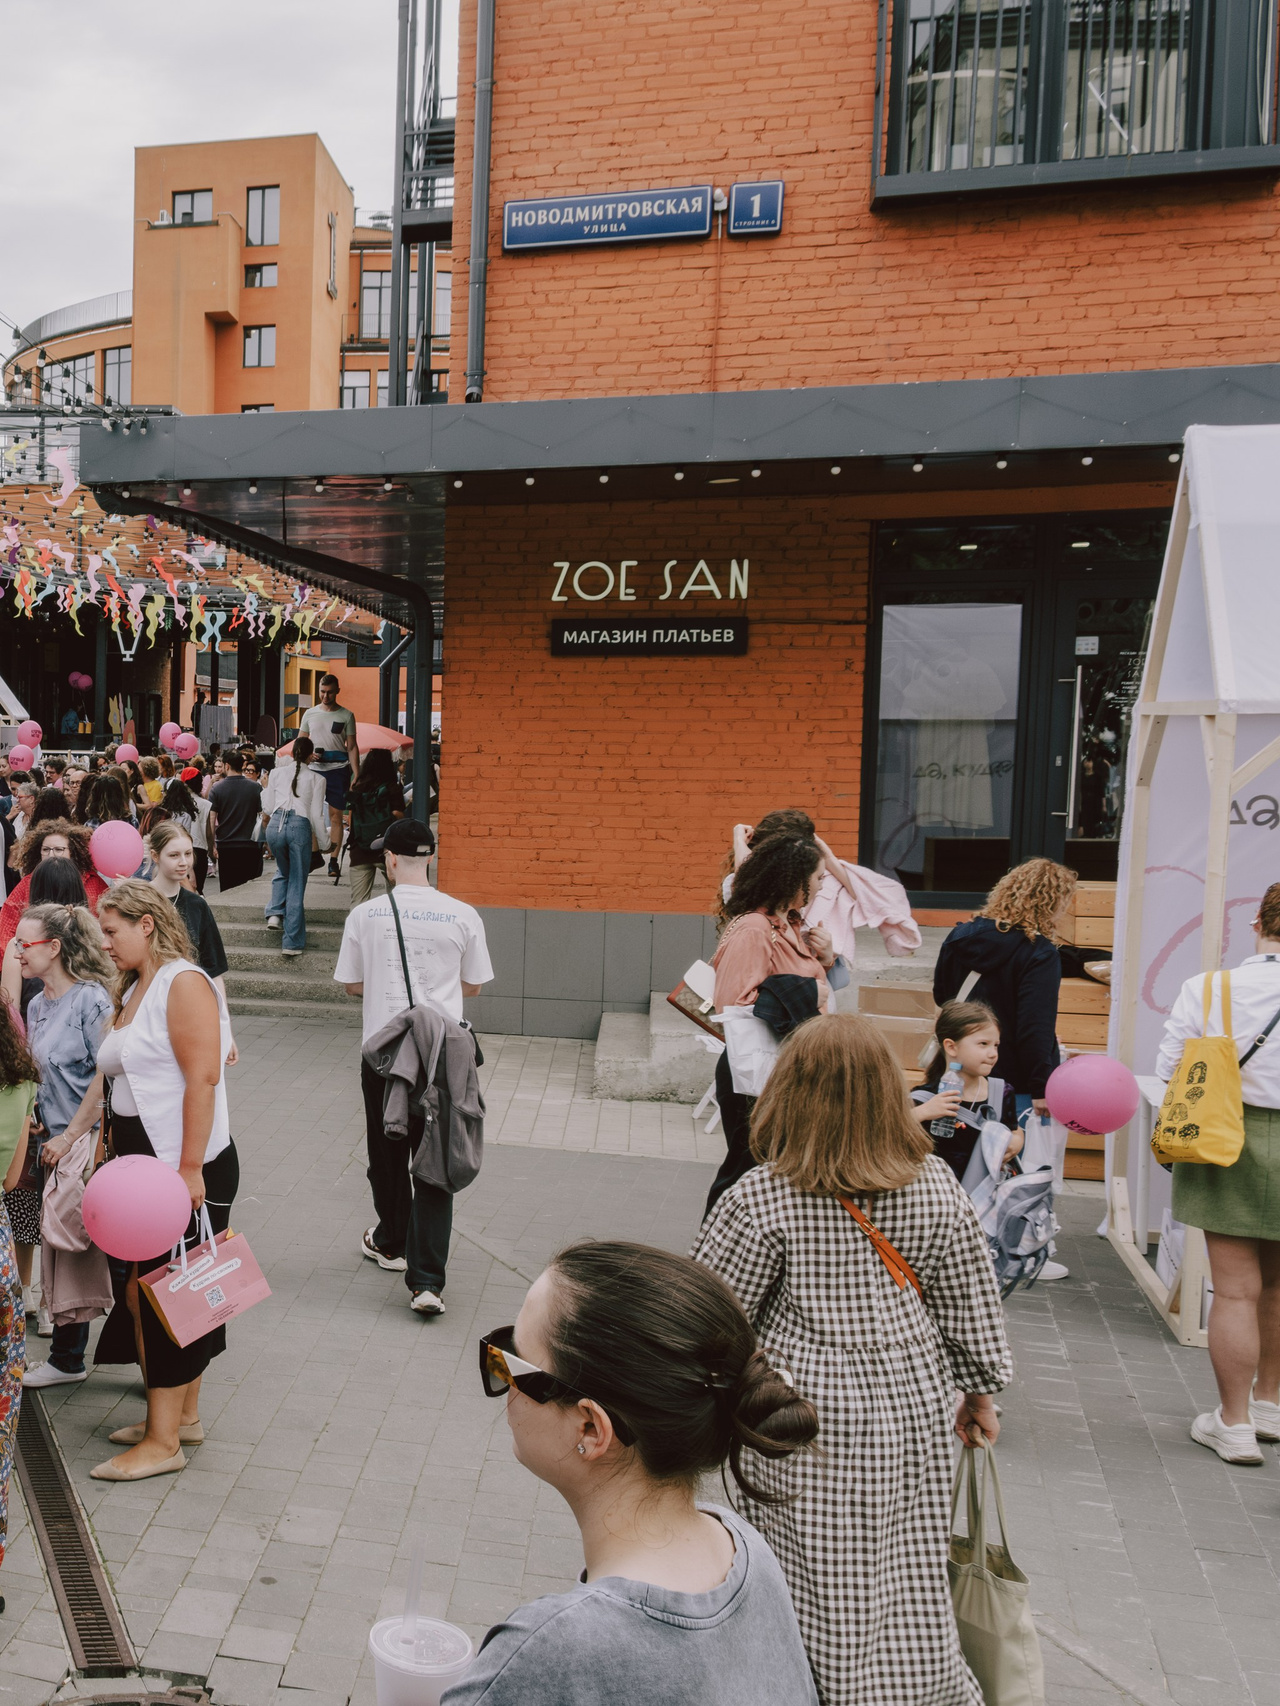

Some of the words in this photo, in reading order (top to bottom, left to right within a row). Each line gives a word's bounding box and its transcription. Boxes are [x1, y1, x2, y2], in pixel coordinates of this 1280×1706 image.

[511, 196, 703, 228] НОВОДМИТРОВСКАЯ
[750, 193, 761, 218] 1
[583, 222, 627, 235] УЛИЦА
[735, 219, 769, 227] СТРОЕНИЕ
[551, 560, 638, 601] ZOE
[659, 558, 749, 600] SAN
[563, 630, 647, 644] МАГАЗИН
[652, 629, 735, 643] ПЛАТЬЕВ
[402, 909, 409, 919] A
[412, 910, 457, 924] GARMENT
